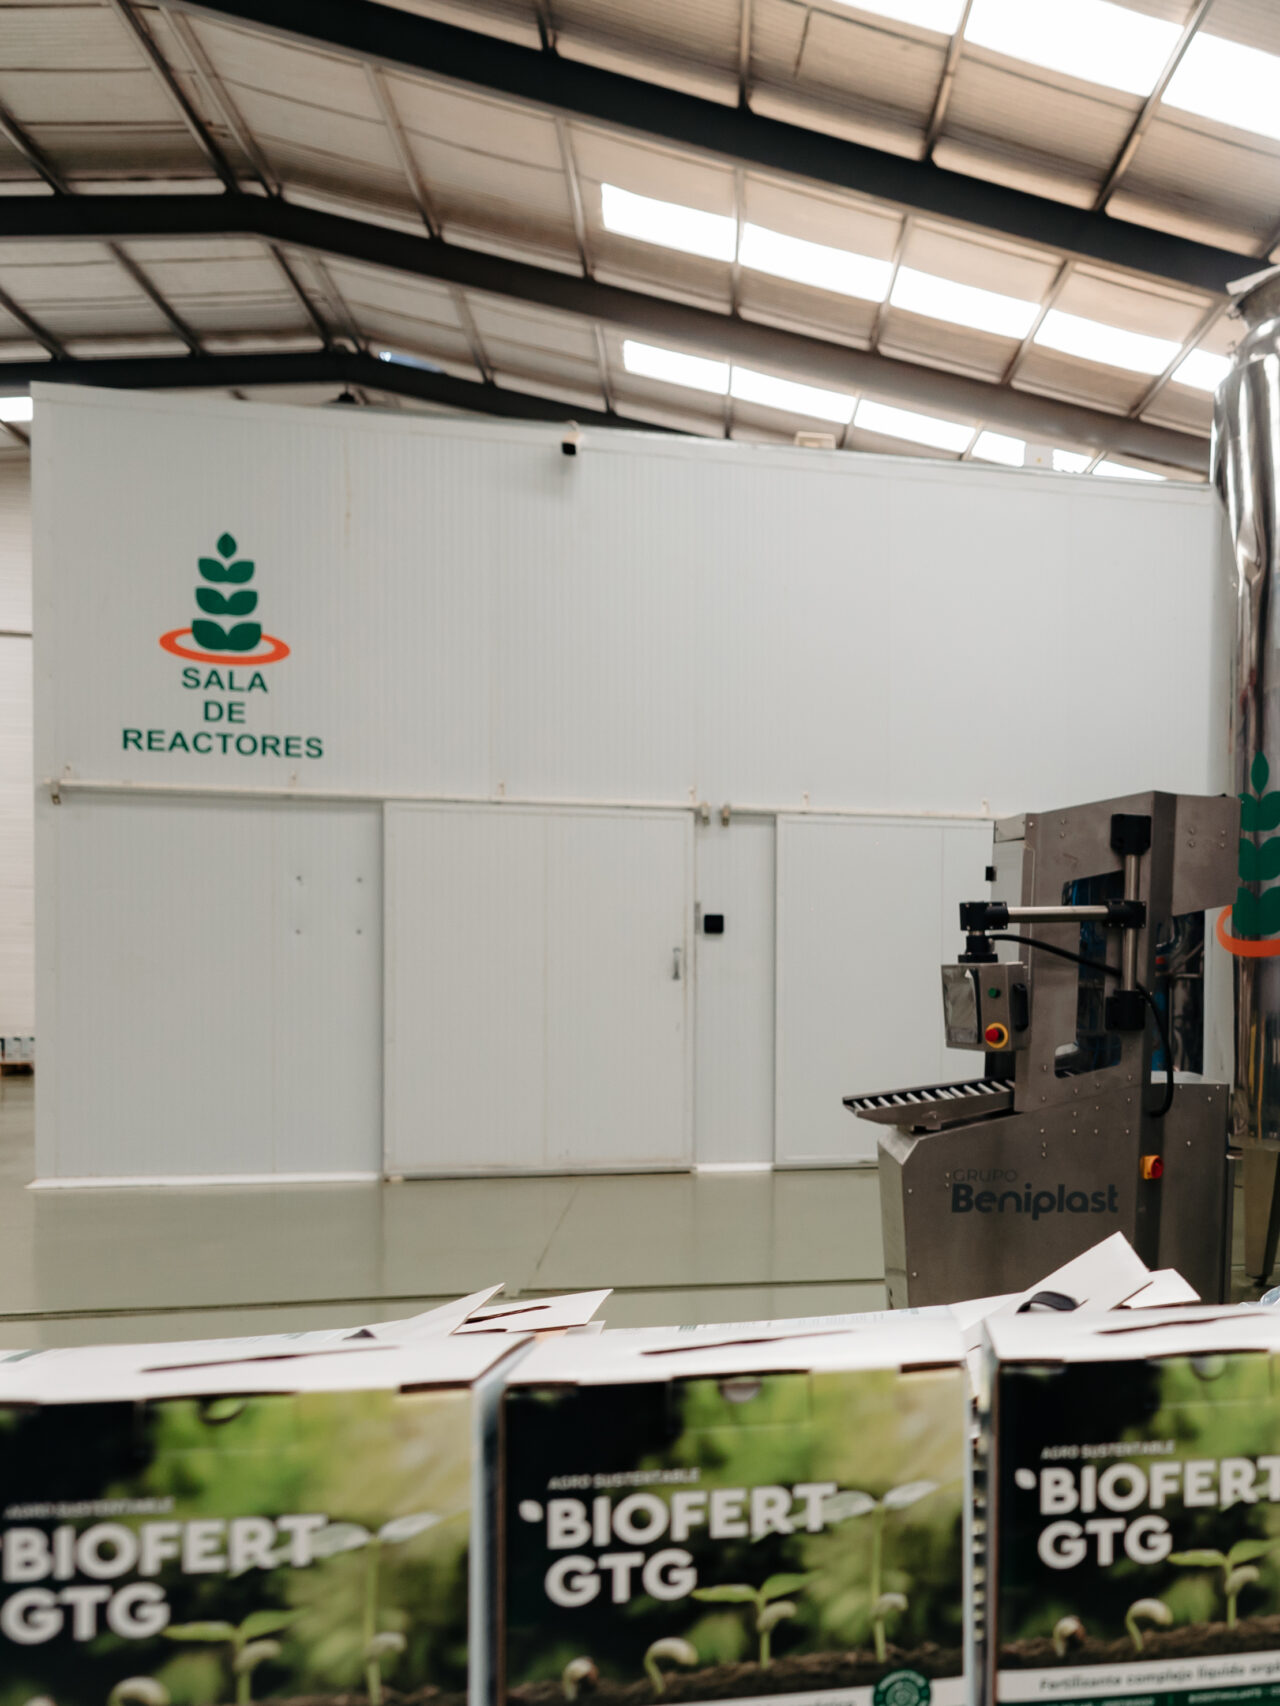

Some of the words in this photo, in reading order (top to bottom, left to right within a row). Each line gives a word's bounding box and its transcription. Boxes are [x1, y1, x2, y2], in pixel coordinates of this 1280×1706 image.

[181, 666, 269, 694] SALA
[203, 700, 246, 724] DE
[122, 728, 324, 760] REACTORES
[952, 1168, 1018, 1183] GRUPO
[952, 1182, 1119, 1222] Beniplast
[546, 1481, 838, 1550] BIOFERT
[1, 1513, 329, 1583] BIOFERT
[1037, 1514, 1173, 1570] GTG
[544, 1549, 698, 1608] GTG
[1, 1581, 171, 1645] GTG
